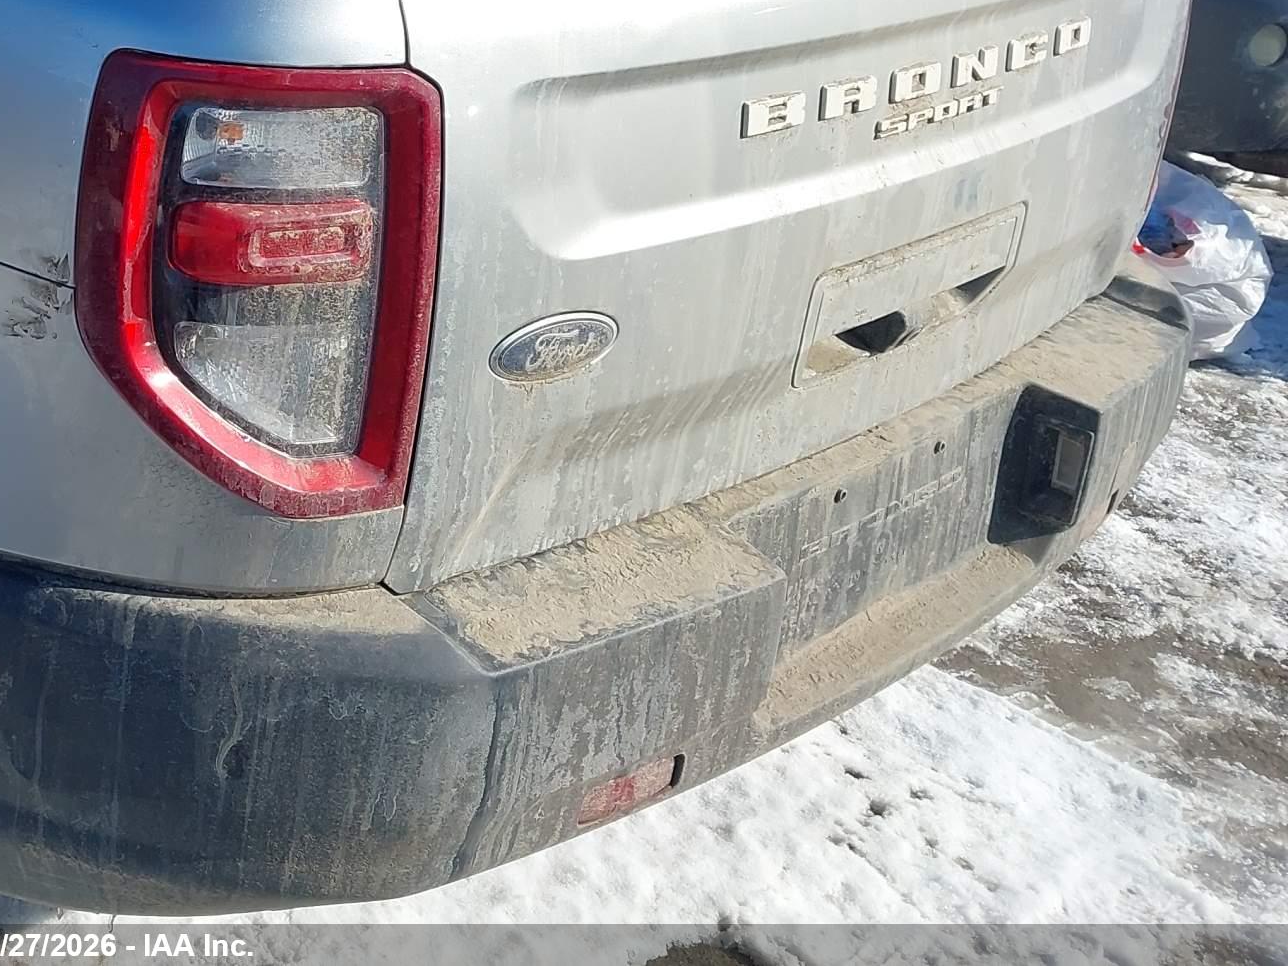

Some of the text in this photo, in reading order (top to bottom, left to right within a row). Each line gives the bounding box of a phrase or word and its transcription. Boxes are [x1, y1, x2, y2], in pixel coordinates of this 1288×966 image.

[740, 15, 1092, 139] BRONCO
[873, 85, 1003, 139] SPORT
[526, 329, 595, 372] Ford
